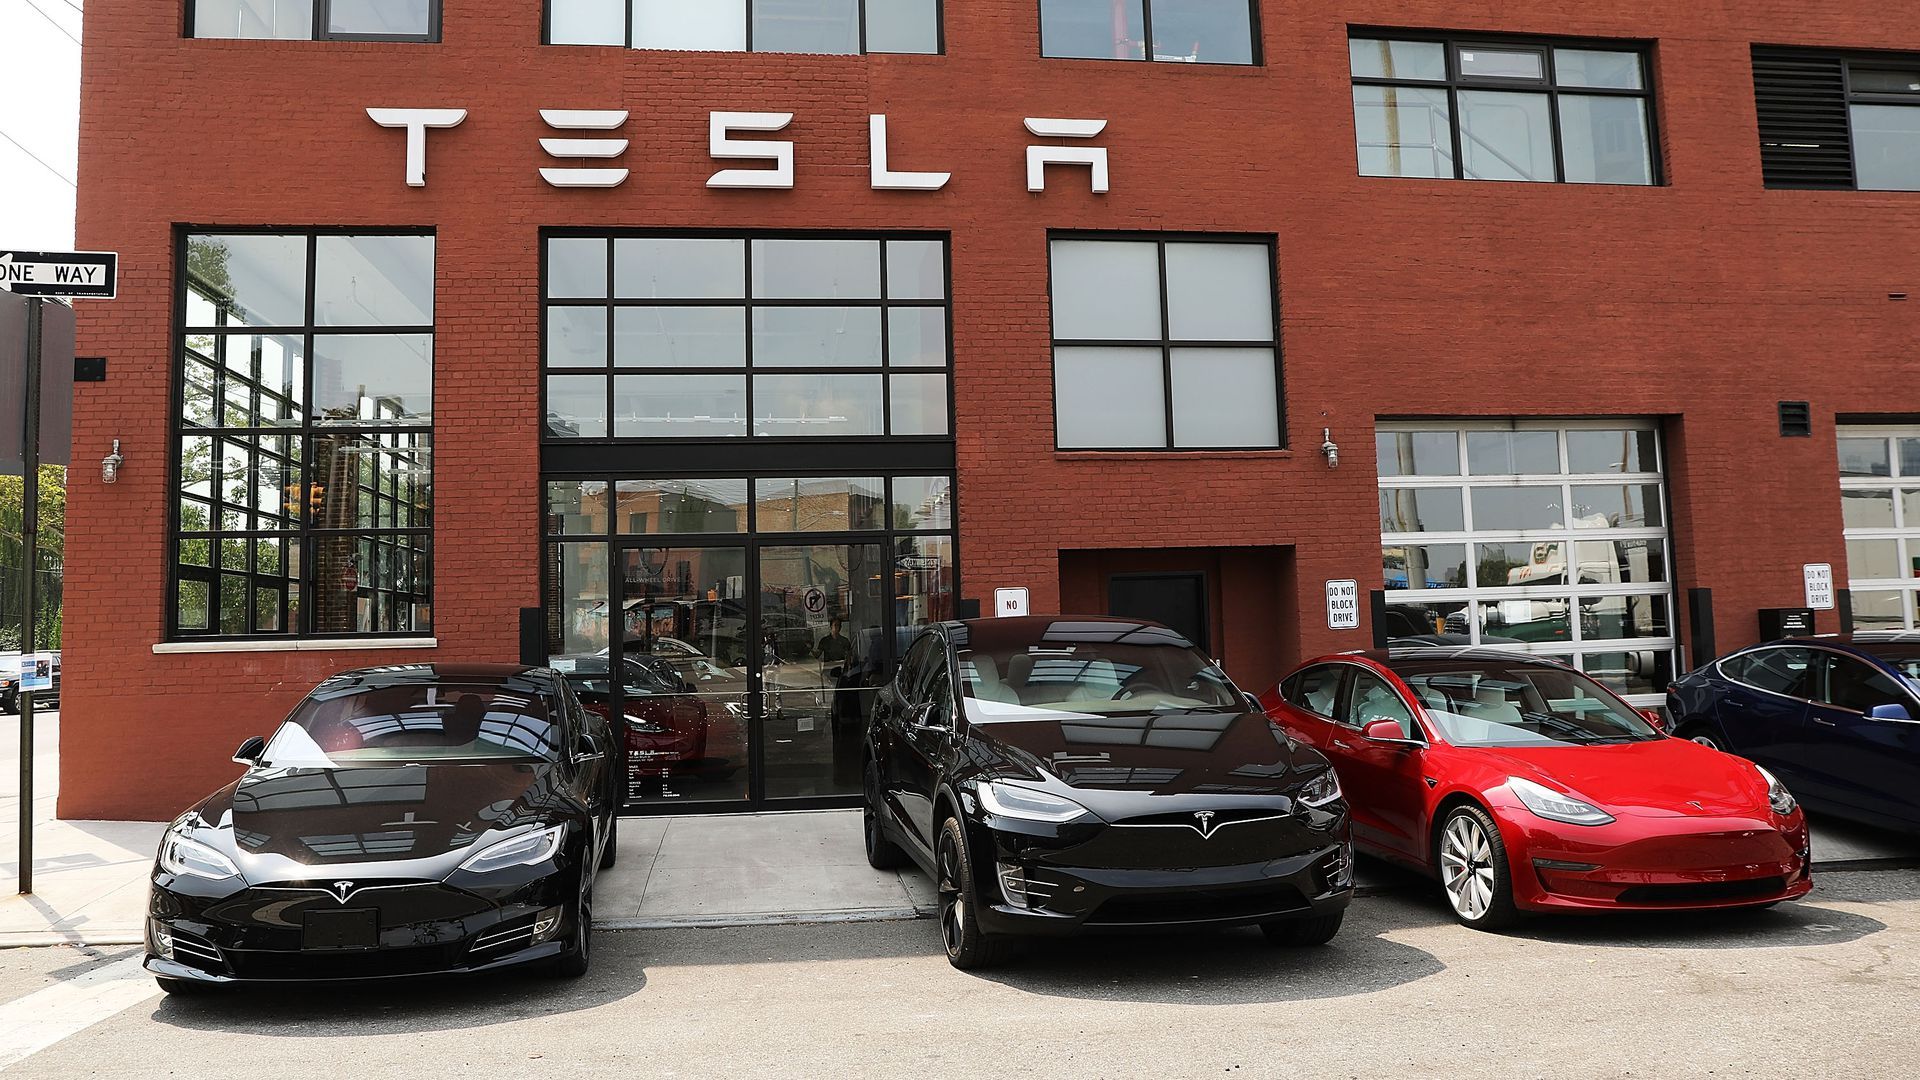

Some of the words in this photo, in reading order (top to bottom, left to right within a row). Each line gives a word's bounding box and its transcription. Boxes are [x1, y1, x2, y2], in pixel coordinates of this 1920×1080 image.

[366, 108, 1108, 192] TESLA
[0, 264, 34, 282] ONE
[55, 265, 97, 283] WAY
[1807, 570, 1815, 579] DO
[1817, 570, 1829, 579] NOT
[1329, 586, 1339, 597] DO
[1341, 586, 1354, 596] NOT
[1809, 582, 1829, 591] BLOCK
[1811, 594, 1829, 603] DRIVE
[1006, 600, 1018, 610] NO
[1331, 599, 1354, 610] BLOCK
[1333, 612, 1354, 623] DRIVE
